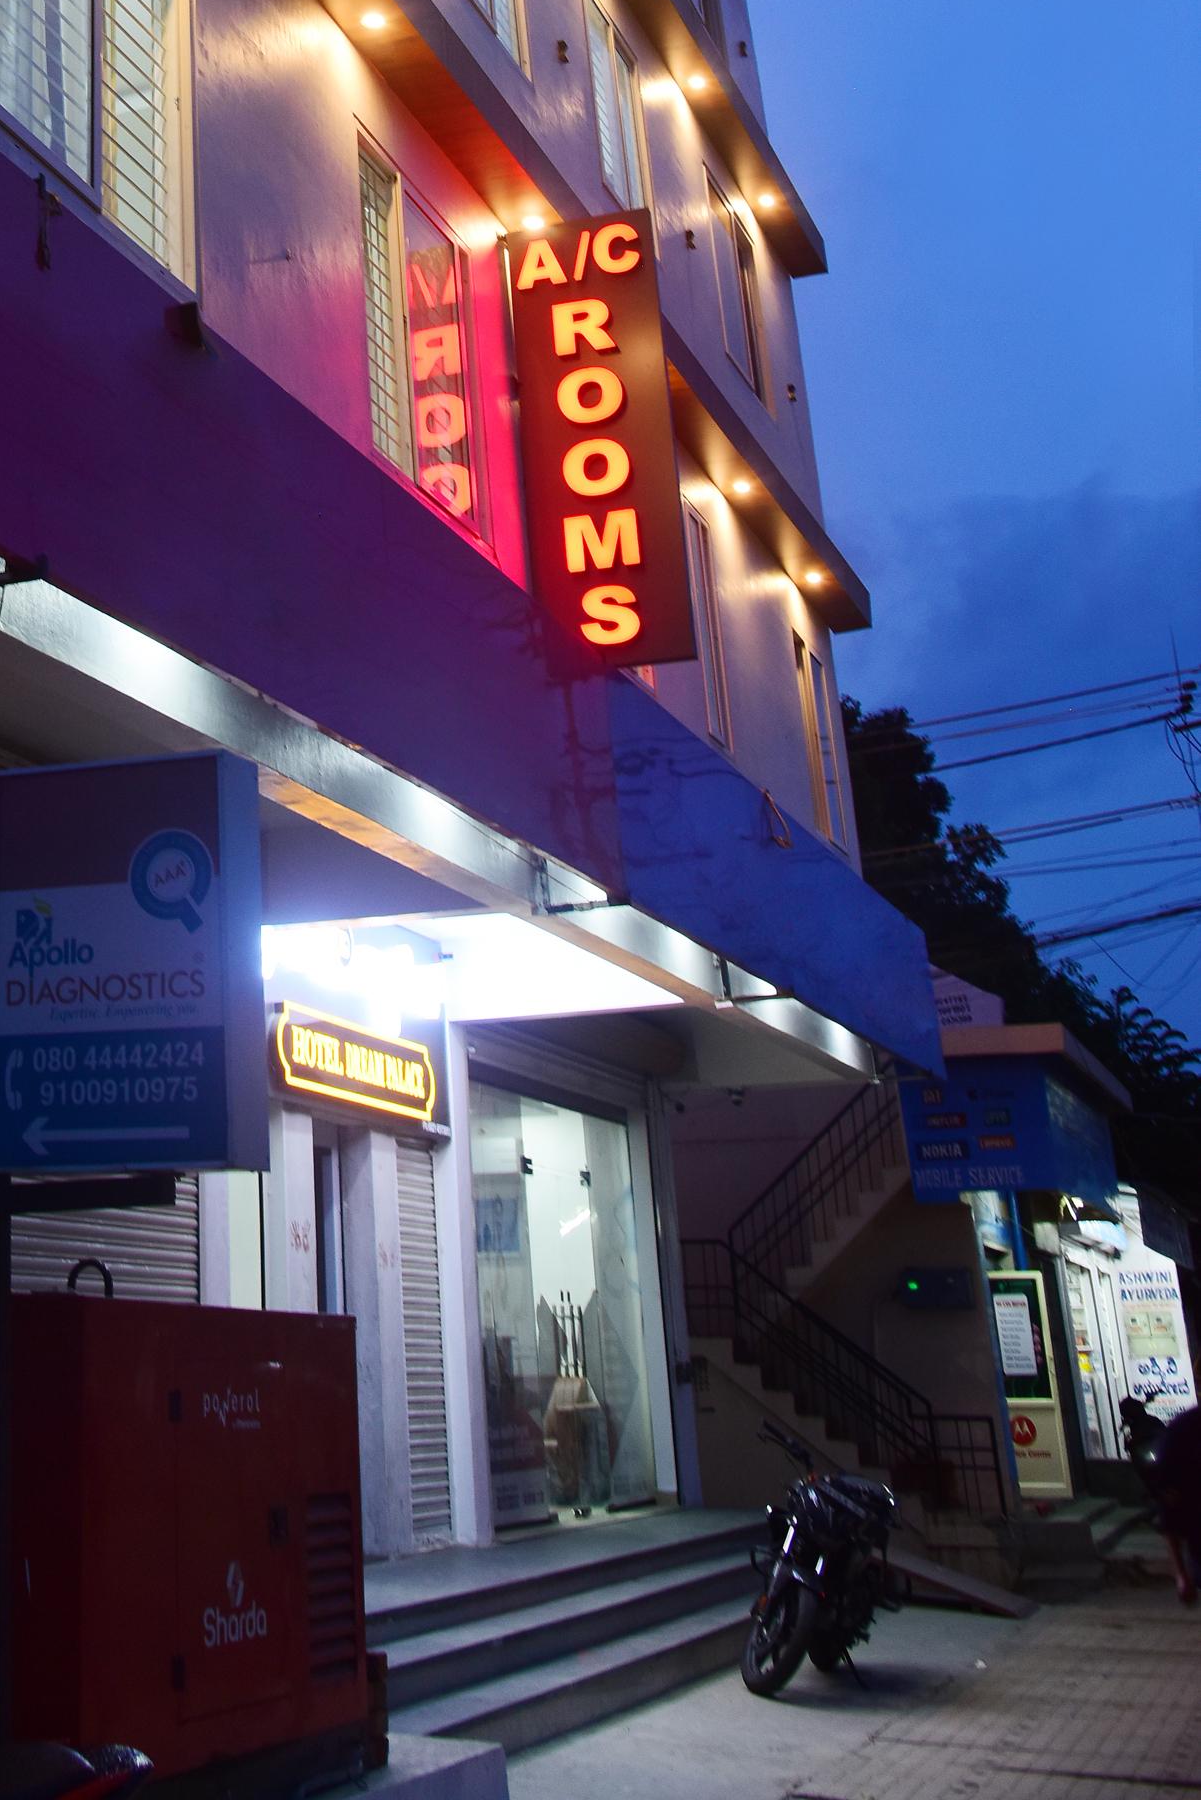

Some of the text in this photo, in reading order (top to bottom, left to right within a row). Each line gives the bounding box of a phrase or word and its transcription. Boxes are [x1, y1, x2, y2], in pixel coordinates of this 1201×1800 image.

[516, 222, 641, 291] A/C
[551, 298, 641, 646] ROOMS
[7, 938, 95, 977] Apollo
[5, 969, 206, 1007] DIAGNOSTICS
[33, 1040, 206, 1073] 080 44442424
[291, 1024, 345, 1077] HOTEL
[385, 1055, 426, 1100] PALACE
[40, 1076, 200, 1106] 9100910975
[921, 1142, 963, 1160] NOKIA
[967, 1164, 1024, 1188] SERVICE
[1118, 1271, 1173, 1286] ASHWINI
[1120, 1287, 1180, 1302] AYURVEDA
[202, 1601, 267, 1649] Sharda
